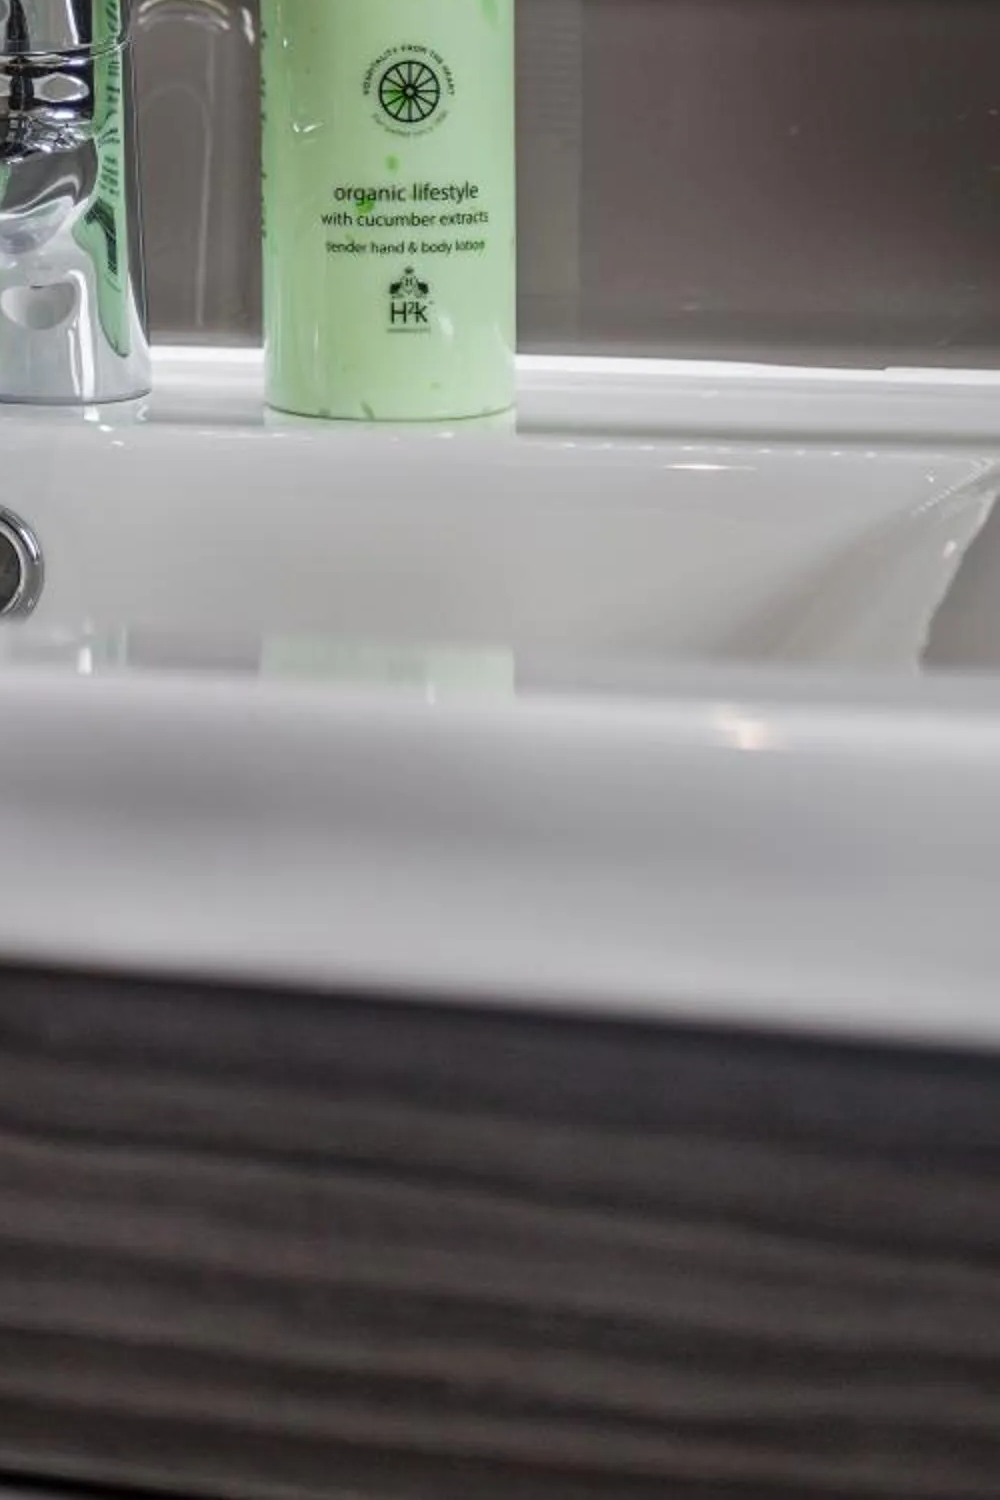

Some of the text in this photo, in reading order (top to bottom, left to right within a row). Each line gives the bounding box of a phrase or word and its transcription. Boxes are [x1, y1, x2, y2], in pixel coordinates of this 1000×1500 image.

[401, 44, 427, 54] FROM
[430, 49, 444, 64] THE
[442, 65, 455, 95] HEART
[333, 180, 479, 205] organic lifestyle
[320, 211, 489, 227] with cucumber extracts
[326, 238, 485, 256] tender hand & body lotion
